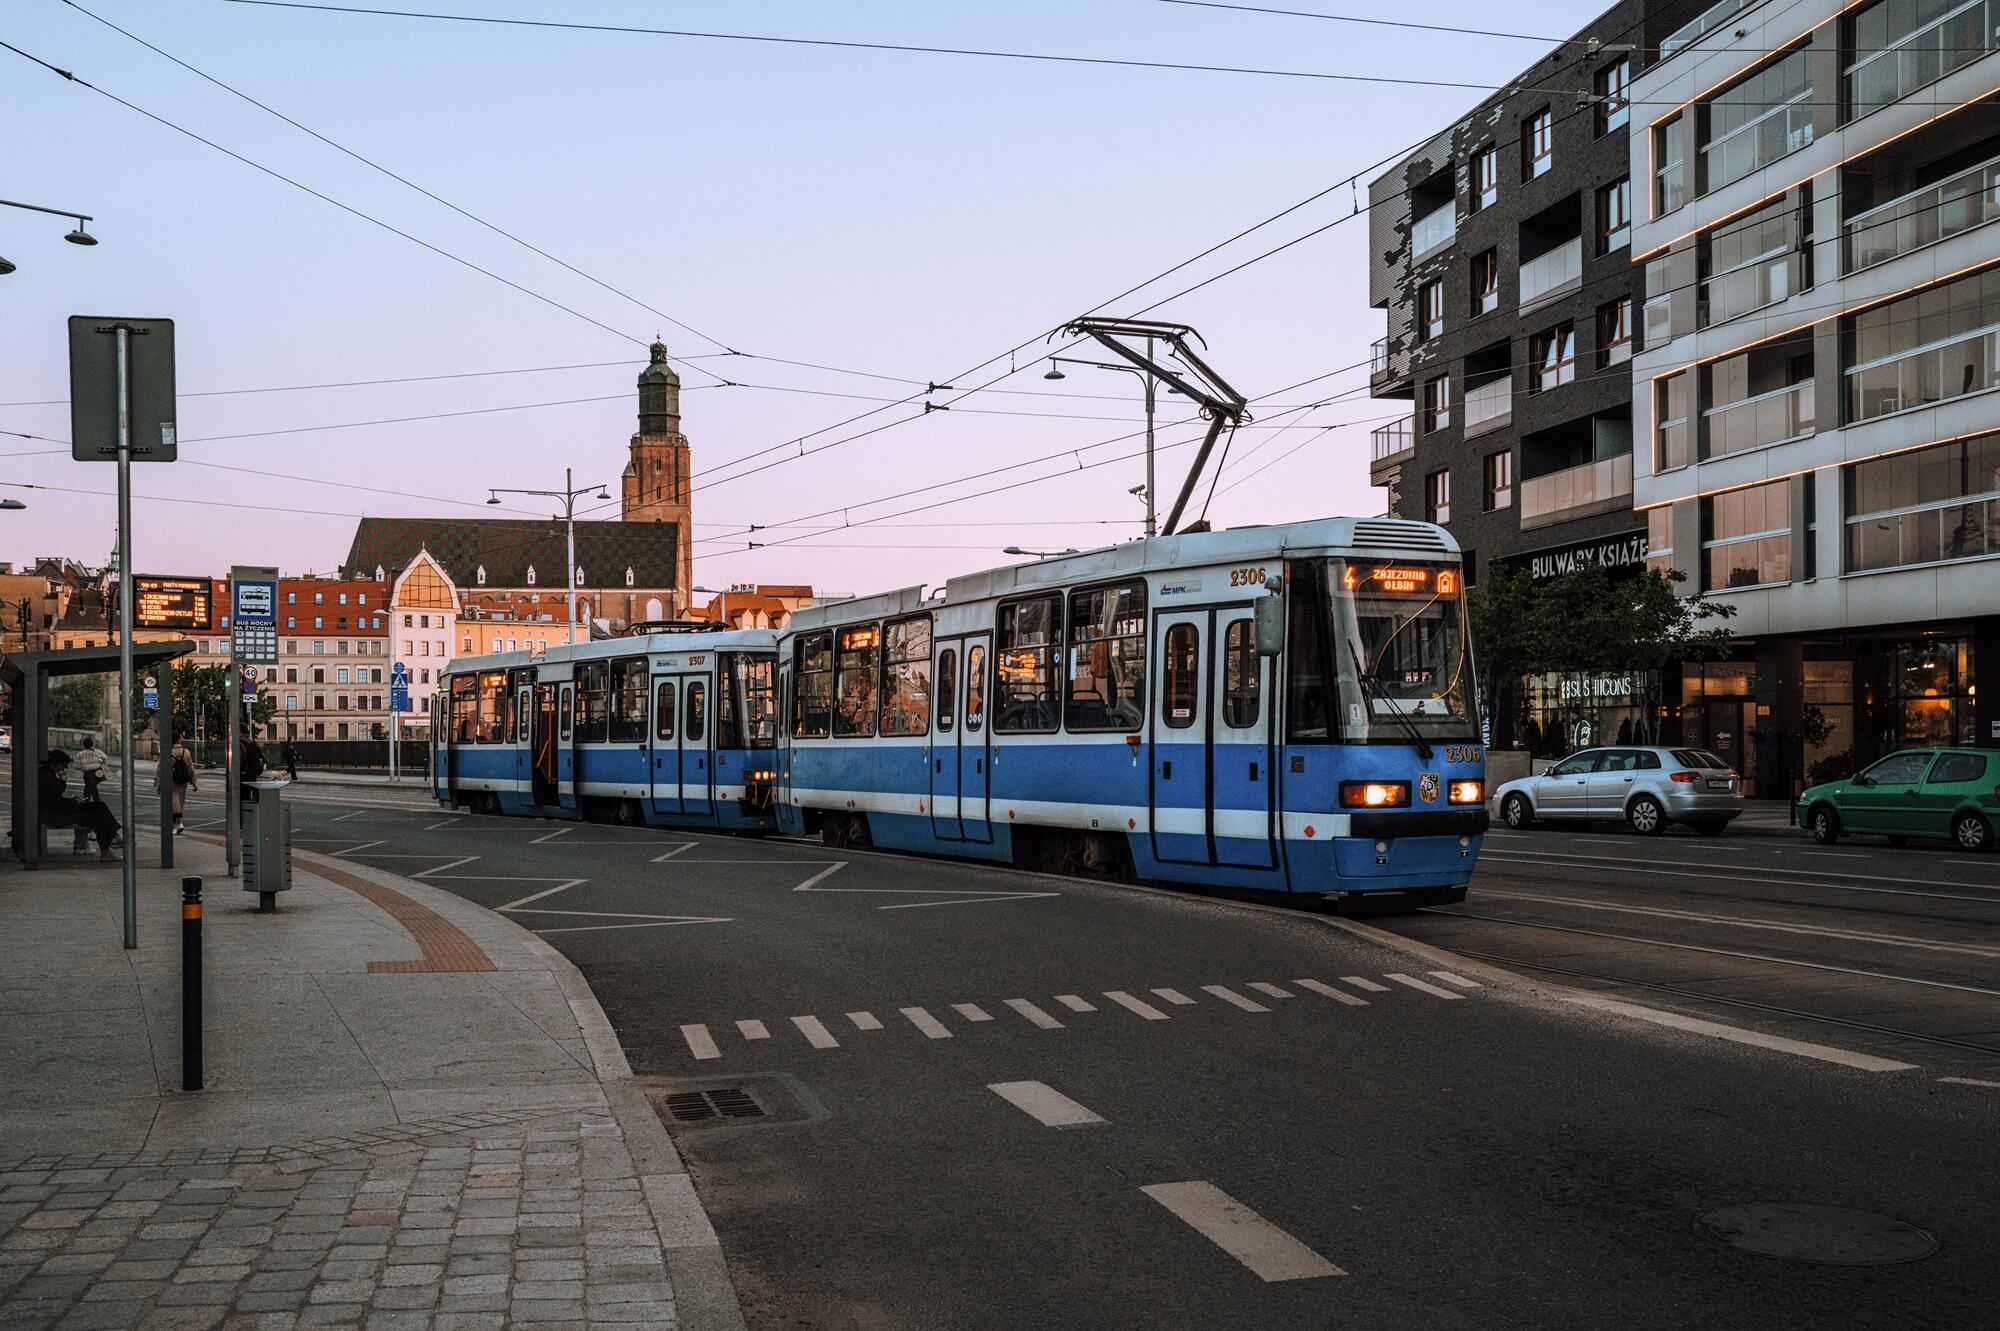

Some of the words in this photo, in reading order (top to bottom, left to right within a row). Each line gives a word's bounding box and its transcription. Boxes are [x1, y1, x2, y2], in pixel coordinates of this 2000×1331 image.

[1531, 547, 1595, 580] BULWARY
[1230, 567, 1266, 587] 2306
[1344, 566, 1354, 590] 4
[1373, 569, 1425, 581] ZAJEZDNIA
[1171, 585, 1187, 595] MPK
[688, 655, 705, 666] 2307
[1445, 745, 1481, 763] 2306
